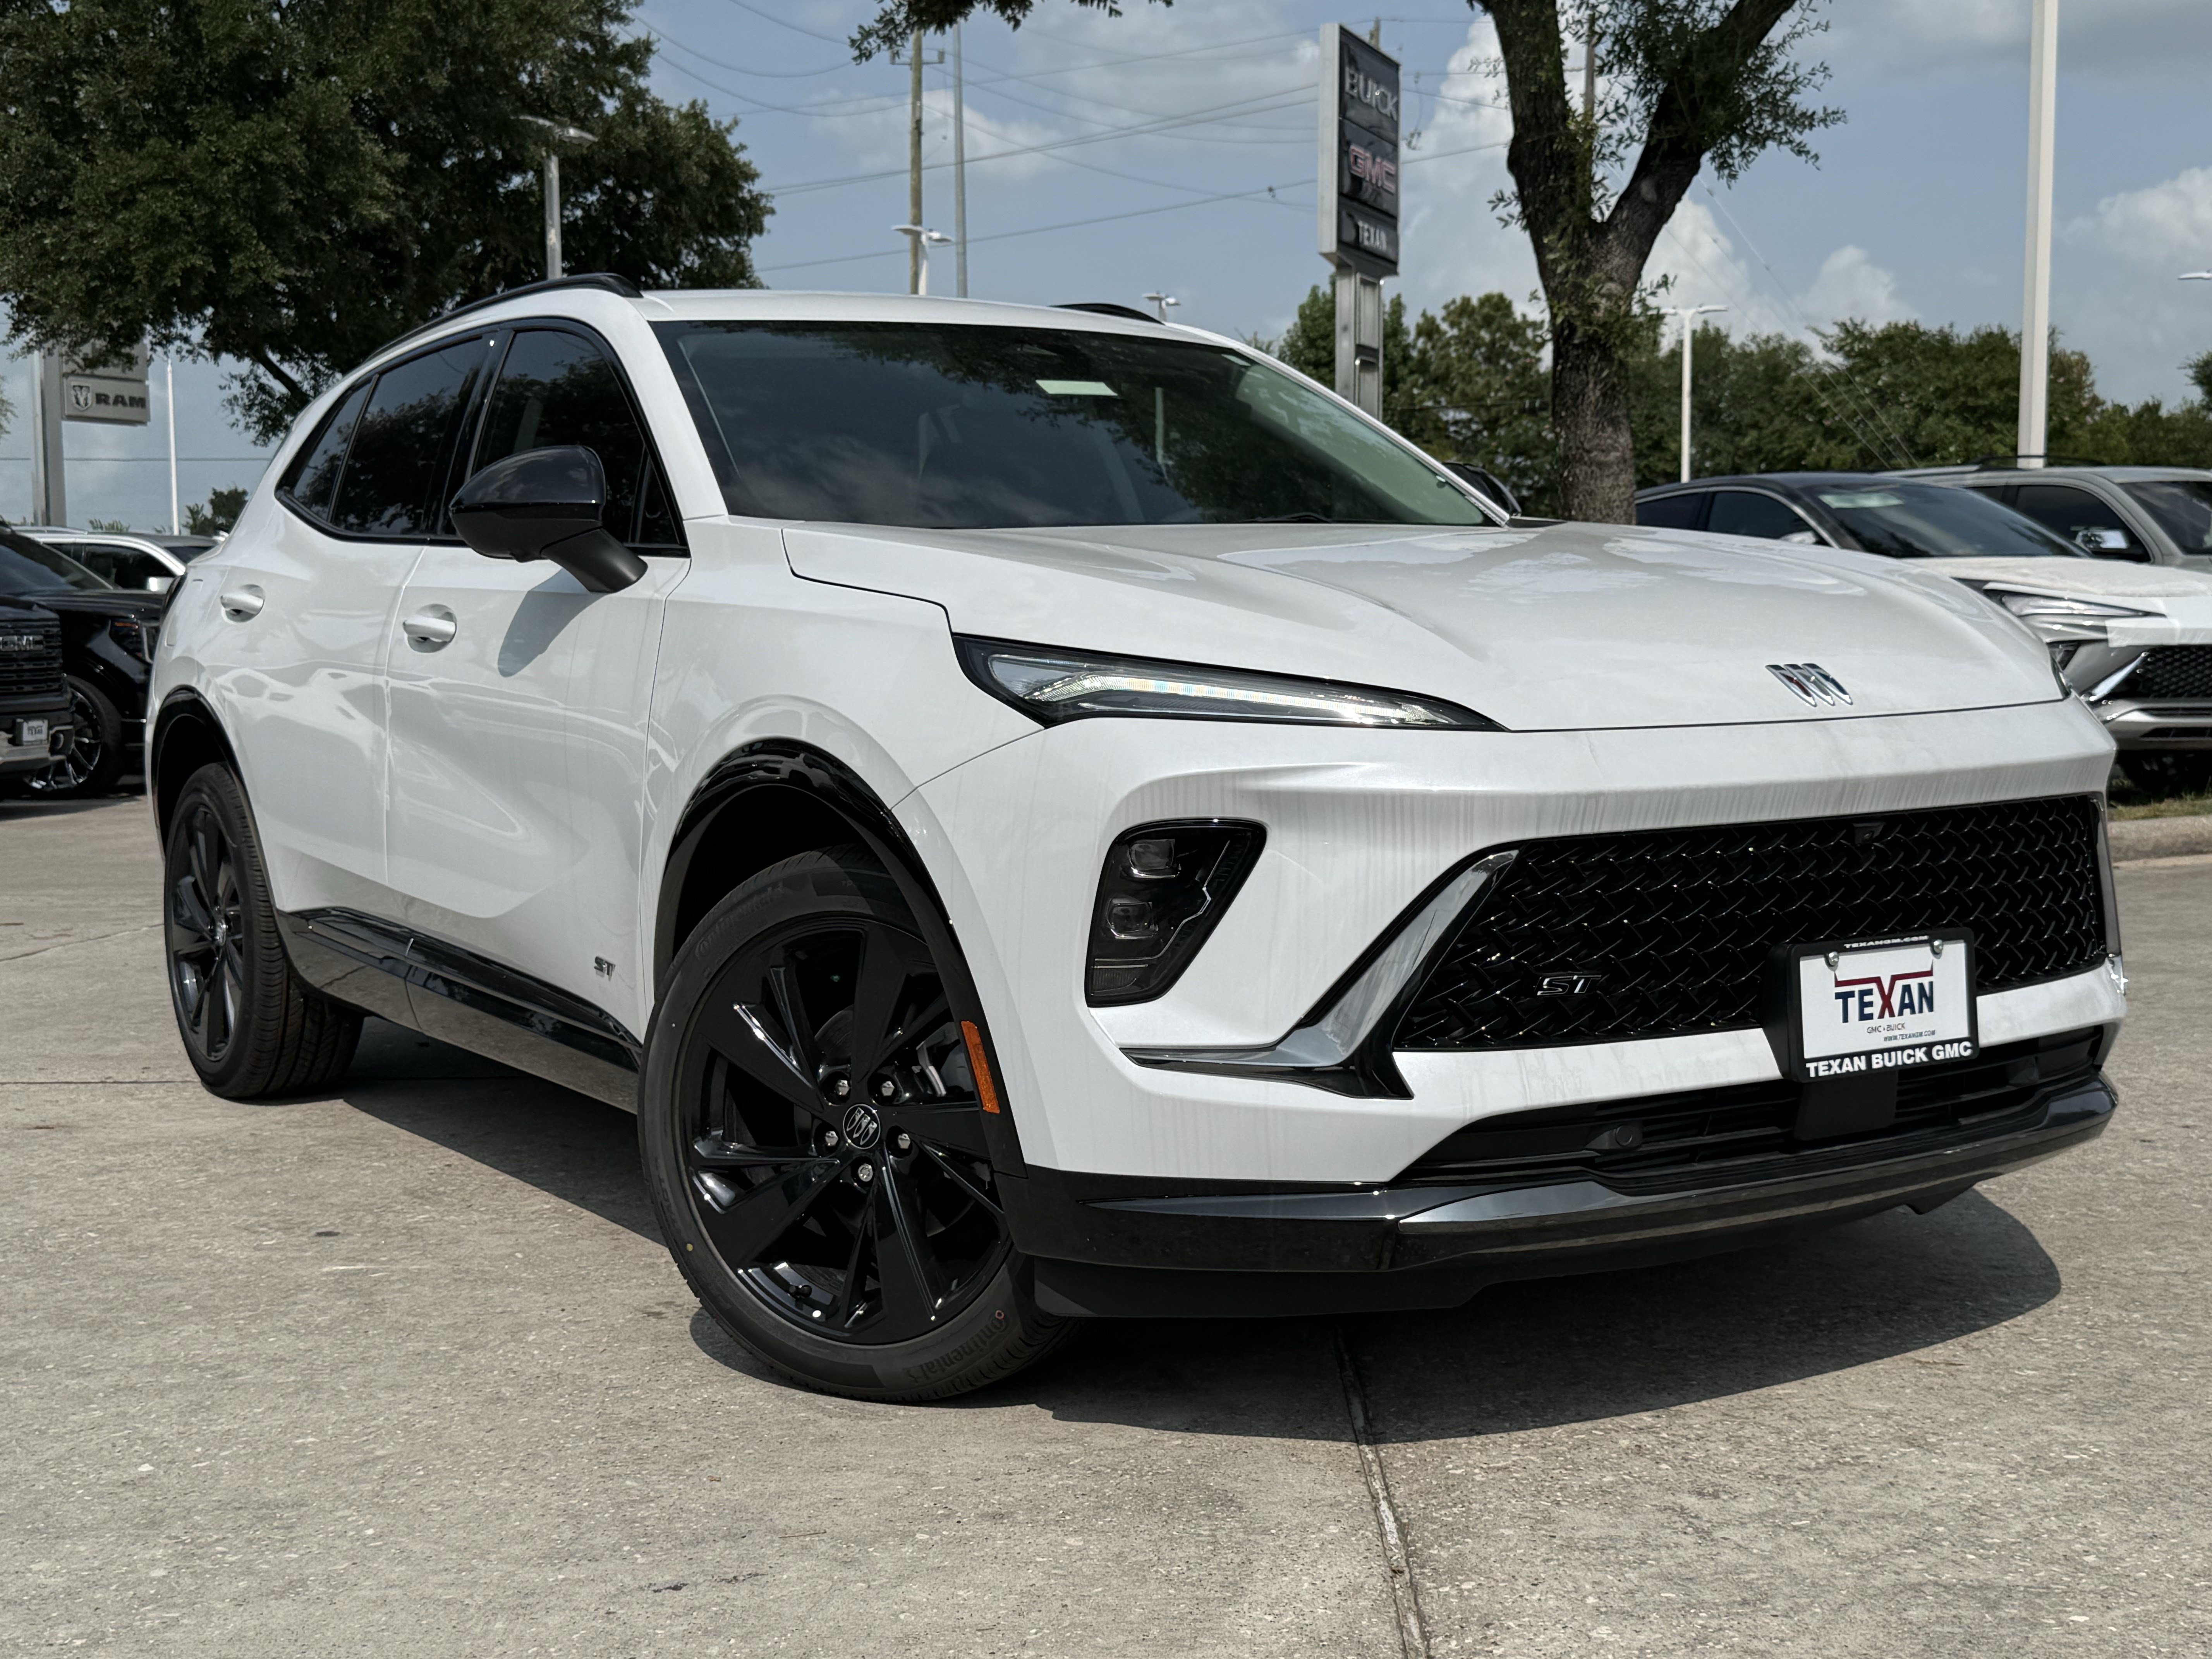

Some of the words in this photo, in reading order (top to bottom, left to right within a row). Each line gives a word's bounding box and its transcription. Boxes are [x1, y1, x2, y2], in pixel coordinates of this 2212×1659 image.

[1345, 65, 1398, 121] BUICK
[1349, 144, 1395, 193] GMC
[95, 393, 146, 409] RAM
[0, 635, 43, 651] GMC
[594, 956, 616, 976] ST
[1537, 975, 1602, 995] ST
[1834, 969, 1934, 1023] TEXAN
[1806, 1056, 1866, 1077] TEXAN
[1872, 1047, 1928, 1069] BUICK
[1932, 1041, 1973, 1060] GMC
